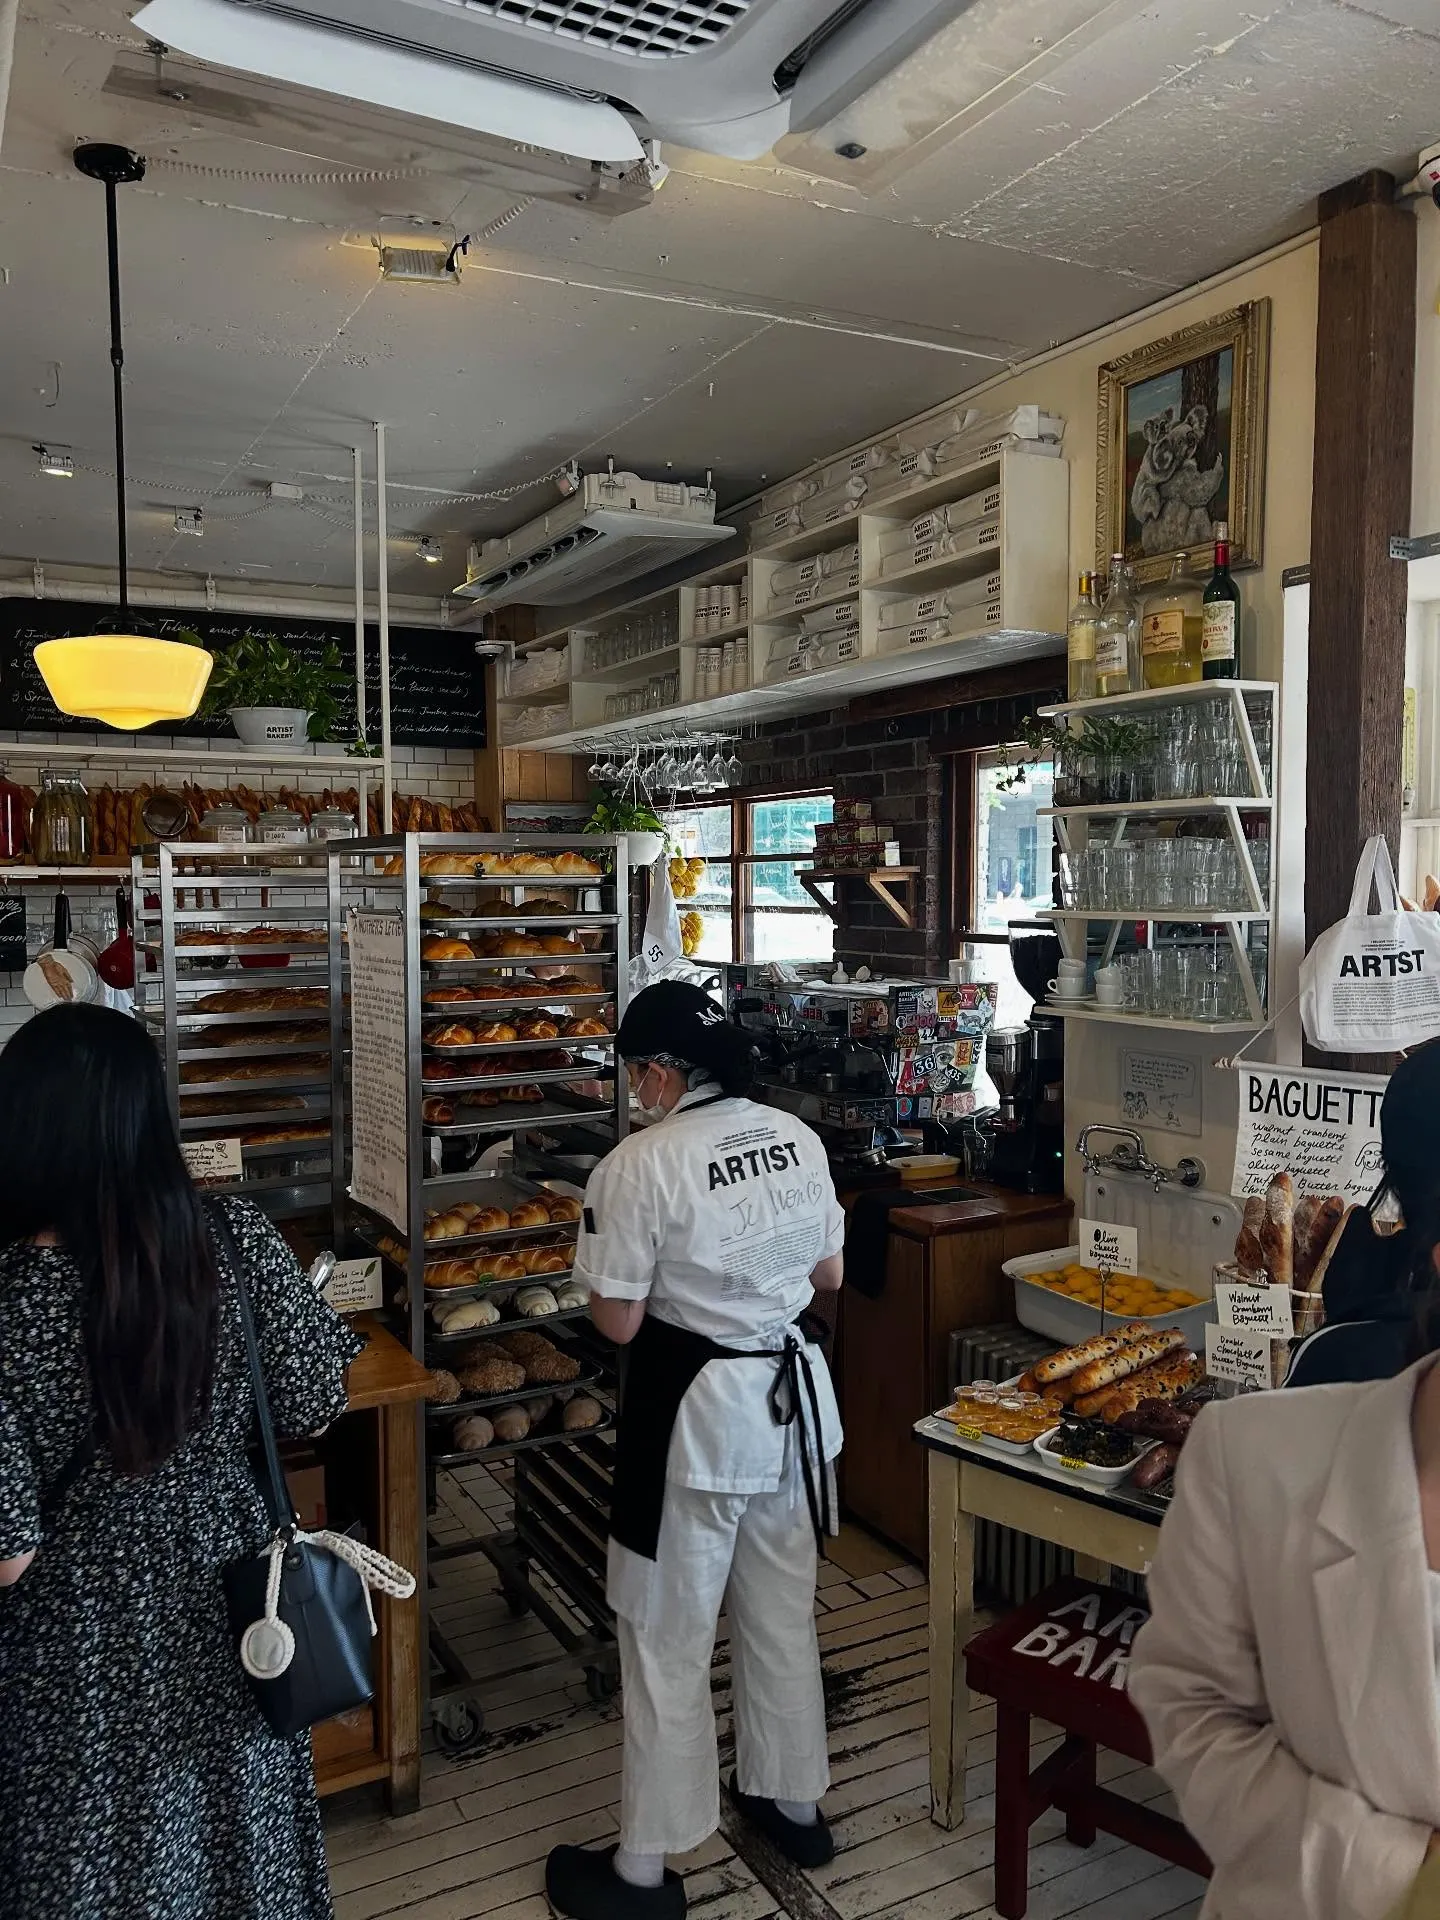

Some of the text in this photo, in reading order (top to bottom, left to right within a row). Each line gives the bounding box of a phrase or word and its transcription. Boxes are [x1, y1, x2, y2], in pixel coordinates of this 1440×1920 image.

[852, 452, 868, 463] ARTIST
[901, 455, 918, 467] ARTIST
[851, 460, 866, 470] BAKERY
[901, 463, 918, 474] BAKERY
[914, 520, 931, 533] ARTIST
[979, 525, 998, 537] ARTIST
[915, 529, 931, 540] BAKERY
[978, 534, 998, 544] BAKERY
[914, 545, 933, 557] ARTIST
[914, 553, 932, 565] BAKERY
[919, 600, 936, 609] ARTIST
[909, 628, 928, 636] ARTIST
[266, 726, 293, 734] ARTIST
[648, 944, 664, 963] 55
[915, 1058, 935, 1075] 36
[947, 1068, 962, 1081] 435
[1293, 1136, 1345, 1153] baguette
[1295, 1151, 1343, 1166] baguette
[708, 1142, 800, 1191] ARTIST
[1284, 1162, 1331, 1178] baguette
[1297, 1177, 1339, 1191] Butter
[1228, 1290, 1262, 1303] Walnut
[1231, 1304, 1274, 1321] Cranberry
[1232, 1314, 1269, 1326] Baguette
[1220, 1335, 1244, 1347] Double
[1216, 1343, 1253, 1360] Chocolate
